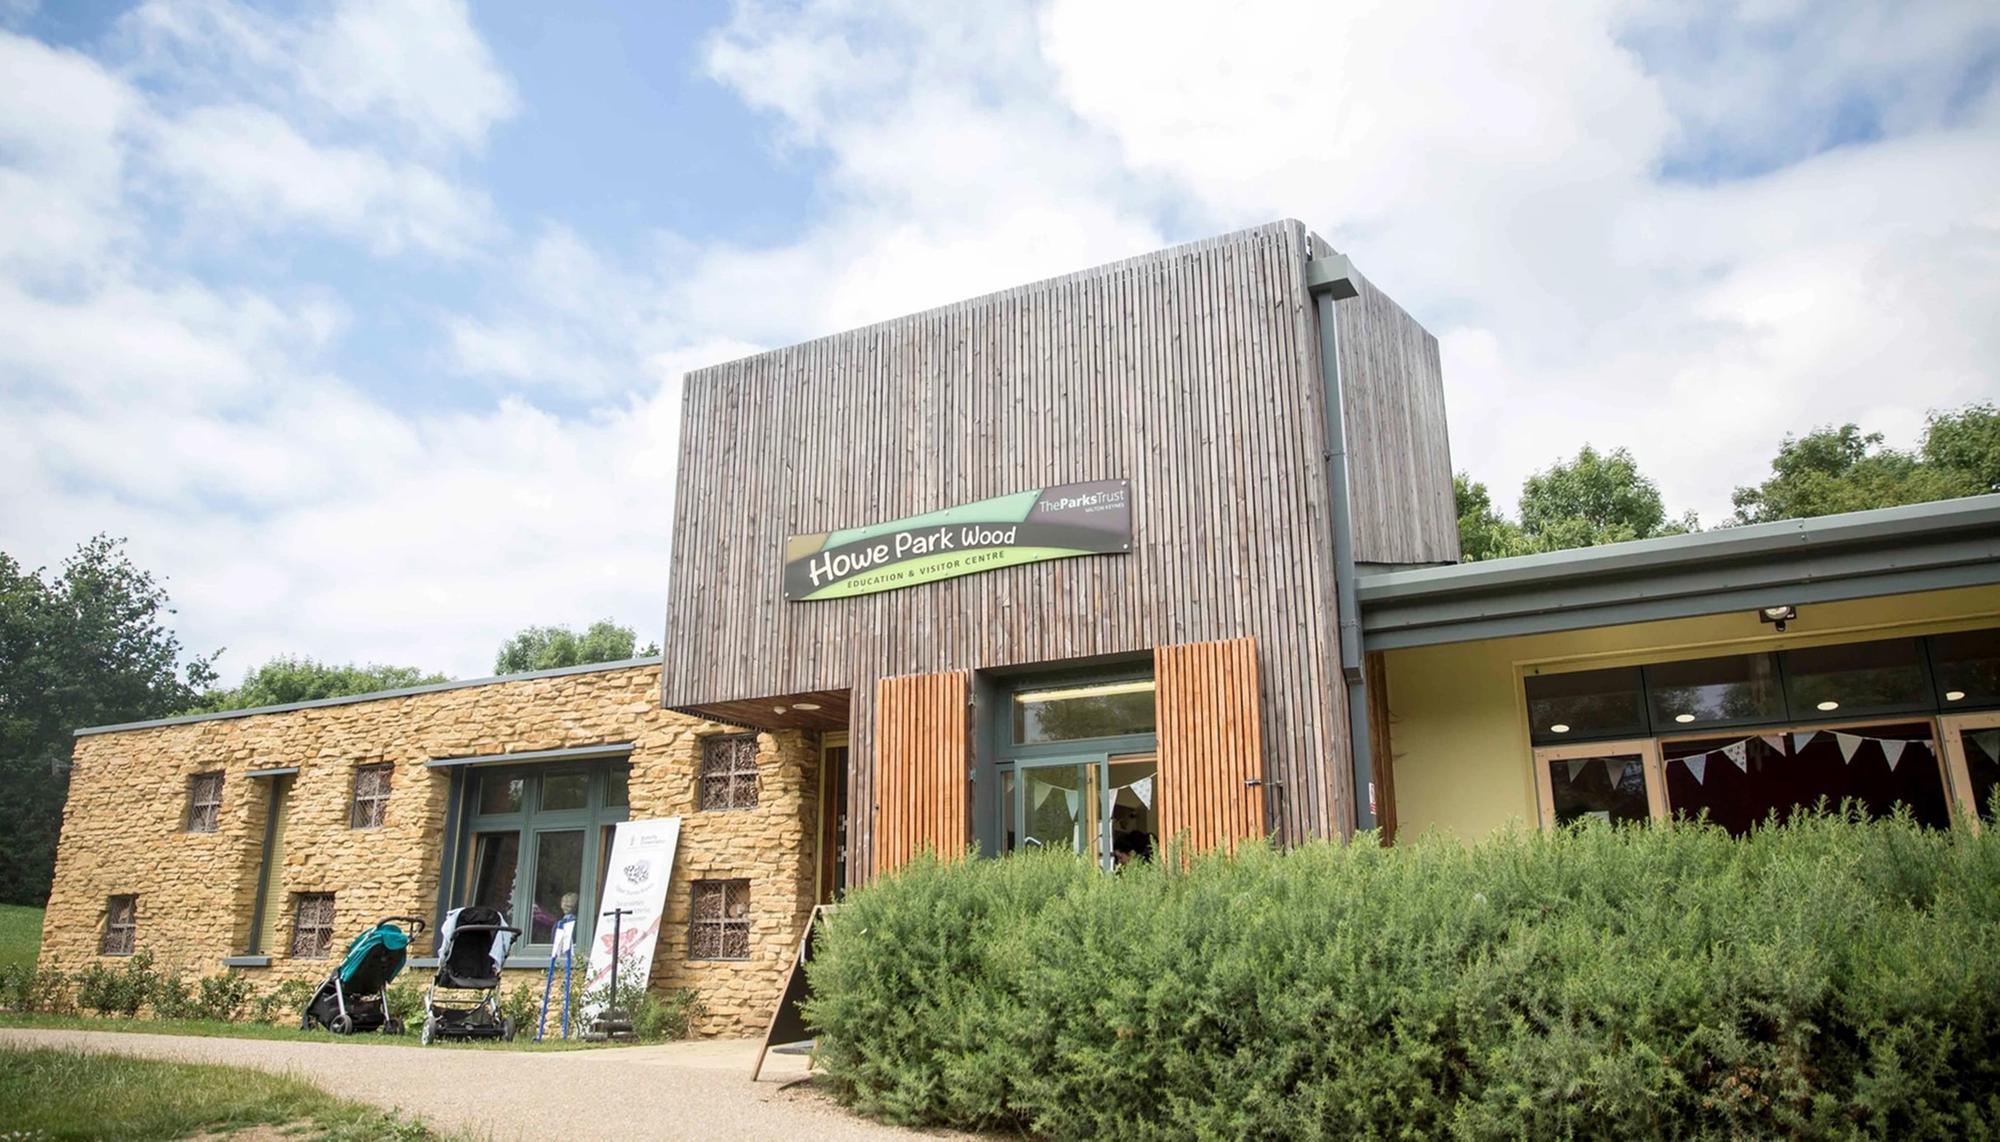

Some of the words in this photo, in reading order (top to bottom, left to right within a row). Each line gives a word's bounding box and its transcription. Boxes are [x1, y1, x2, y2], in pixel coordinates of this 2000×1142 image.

[809, 544, 889, 587] Howe
[895, 527, 954, 558] Park
[961, 525, 1017, 547] Wood
[847, 572, 904, 589] EDUCATION
[908, 569, 915, 578] &
[919, 559, 960, 575] VISITOR
[965, 550, 1005, 566] CENTRE
